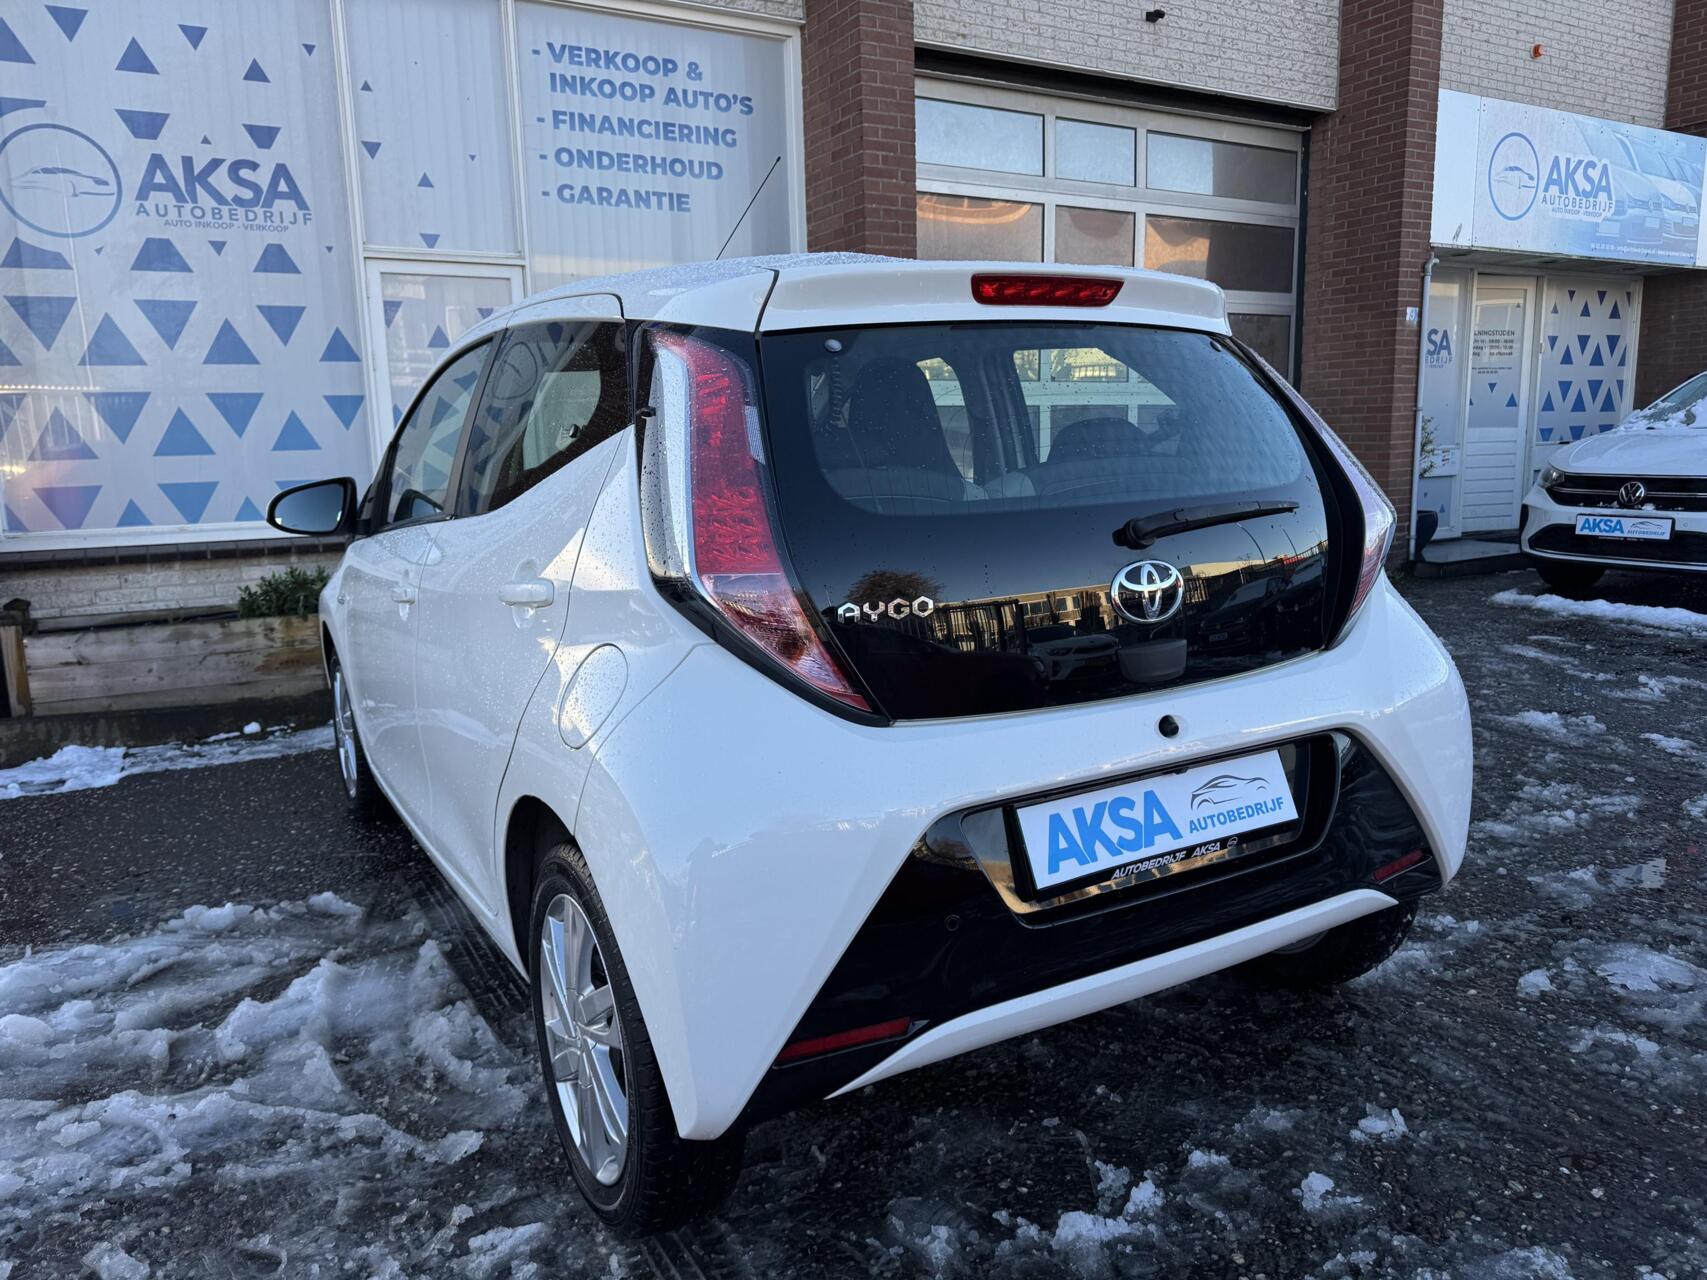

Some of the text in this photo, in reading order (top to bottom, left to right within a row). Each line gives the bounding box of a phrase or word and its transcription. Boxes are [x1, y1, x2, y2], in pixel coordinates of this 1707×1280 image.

[546, 42, 678, 77] VERKOOP
[686, 61, 703, 81] &
[549, 72, 754, 116] INKOOP AUTO'S
[552, 110, 738, 148] FINANCIERING
[135, 153, 311, 212] AKSA
[554, 147, 724, 181] ONDERHOUD
[1542, 155, 1613, 201] AKSA
[136, 203, 312, 226] AUTOBEDRIJF
[557, 184, 692, 213] GARANTIE
[1541, 194, 1614, 213] AUTOBEDRIJF
[164, 219, 193, 229] AUTO
[195, 221, 235, 231] INKOOP
[243, 223, 289, 233] VERKOOP
[1580, 518, 1625, 534] AKSA
[836, 595, 935, 625] AYGO
[1047, 789, 1184, 876] AKSA
[1188, 796, 1285, 834] AUTOBEDRIJF
[1111, 841, 1221, 880] AUTOBEDRIJF AKSA
